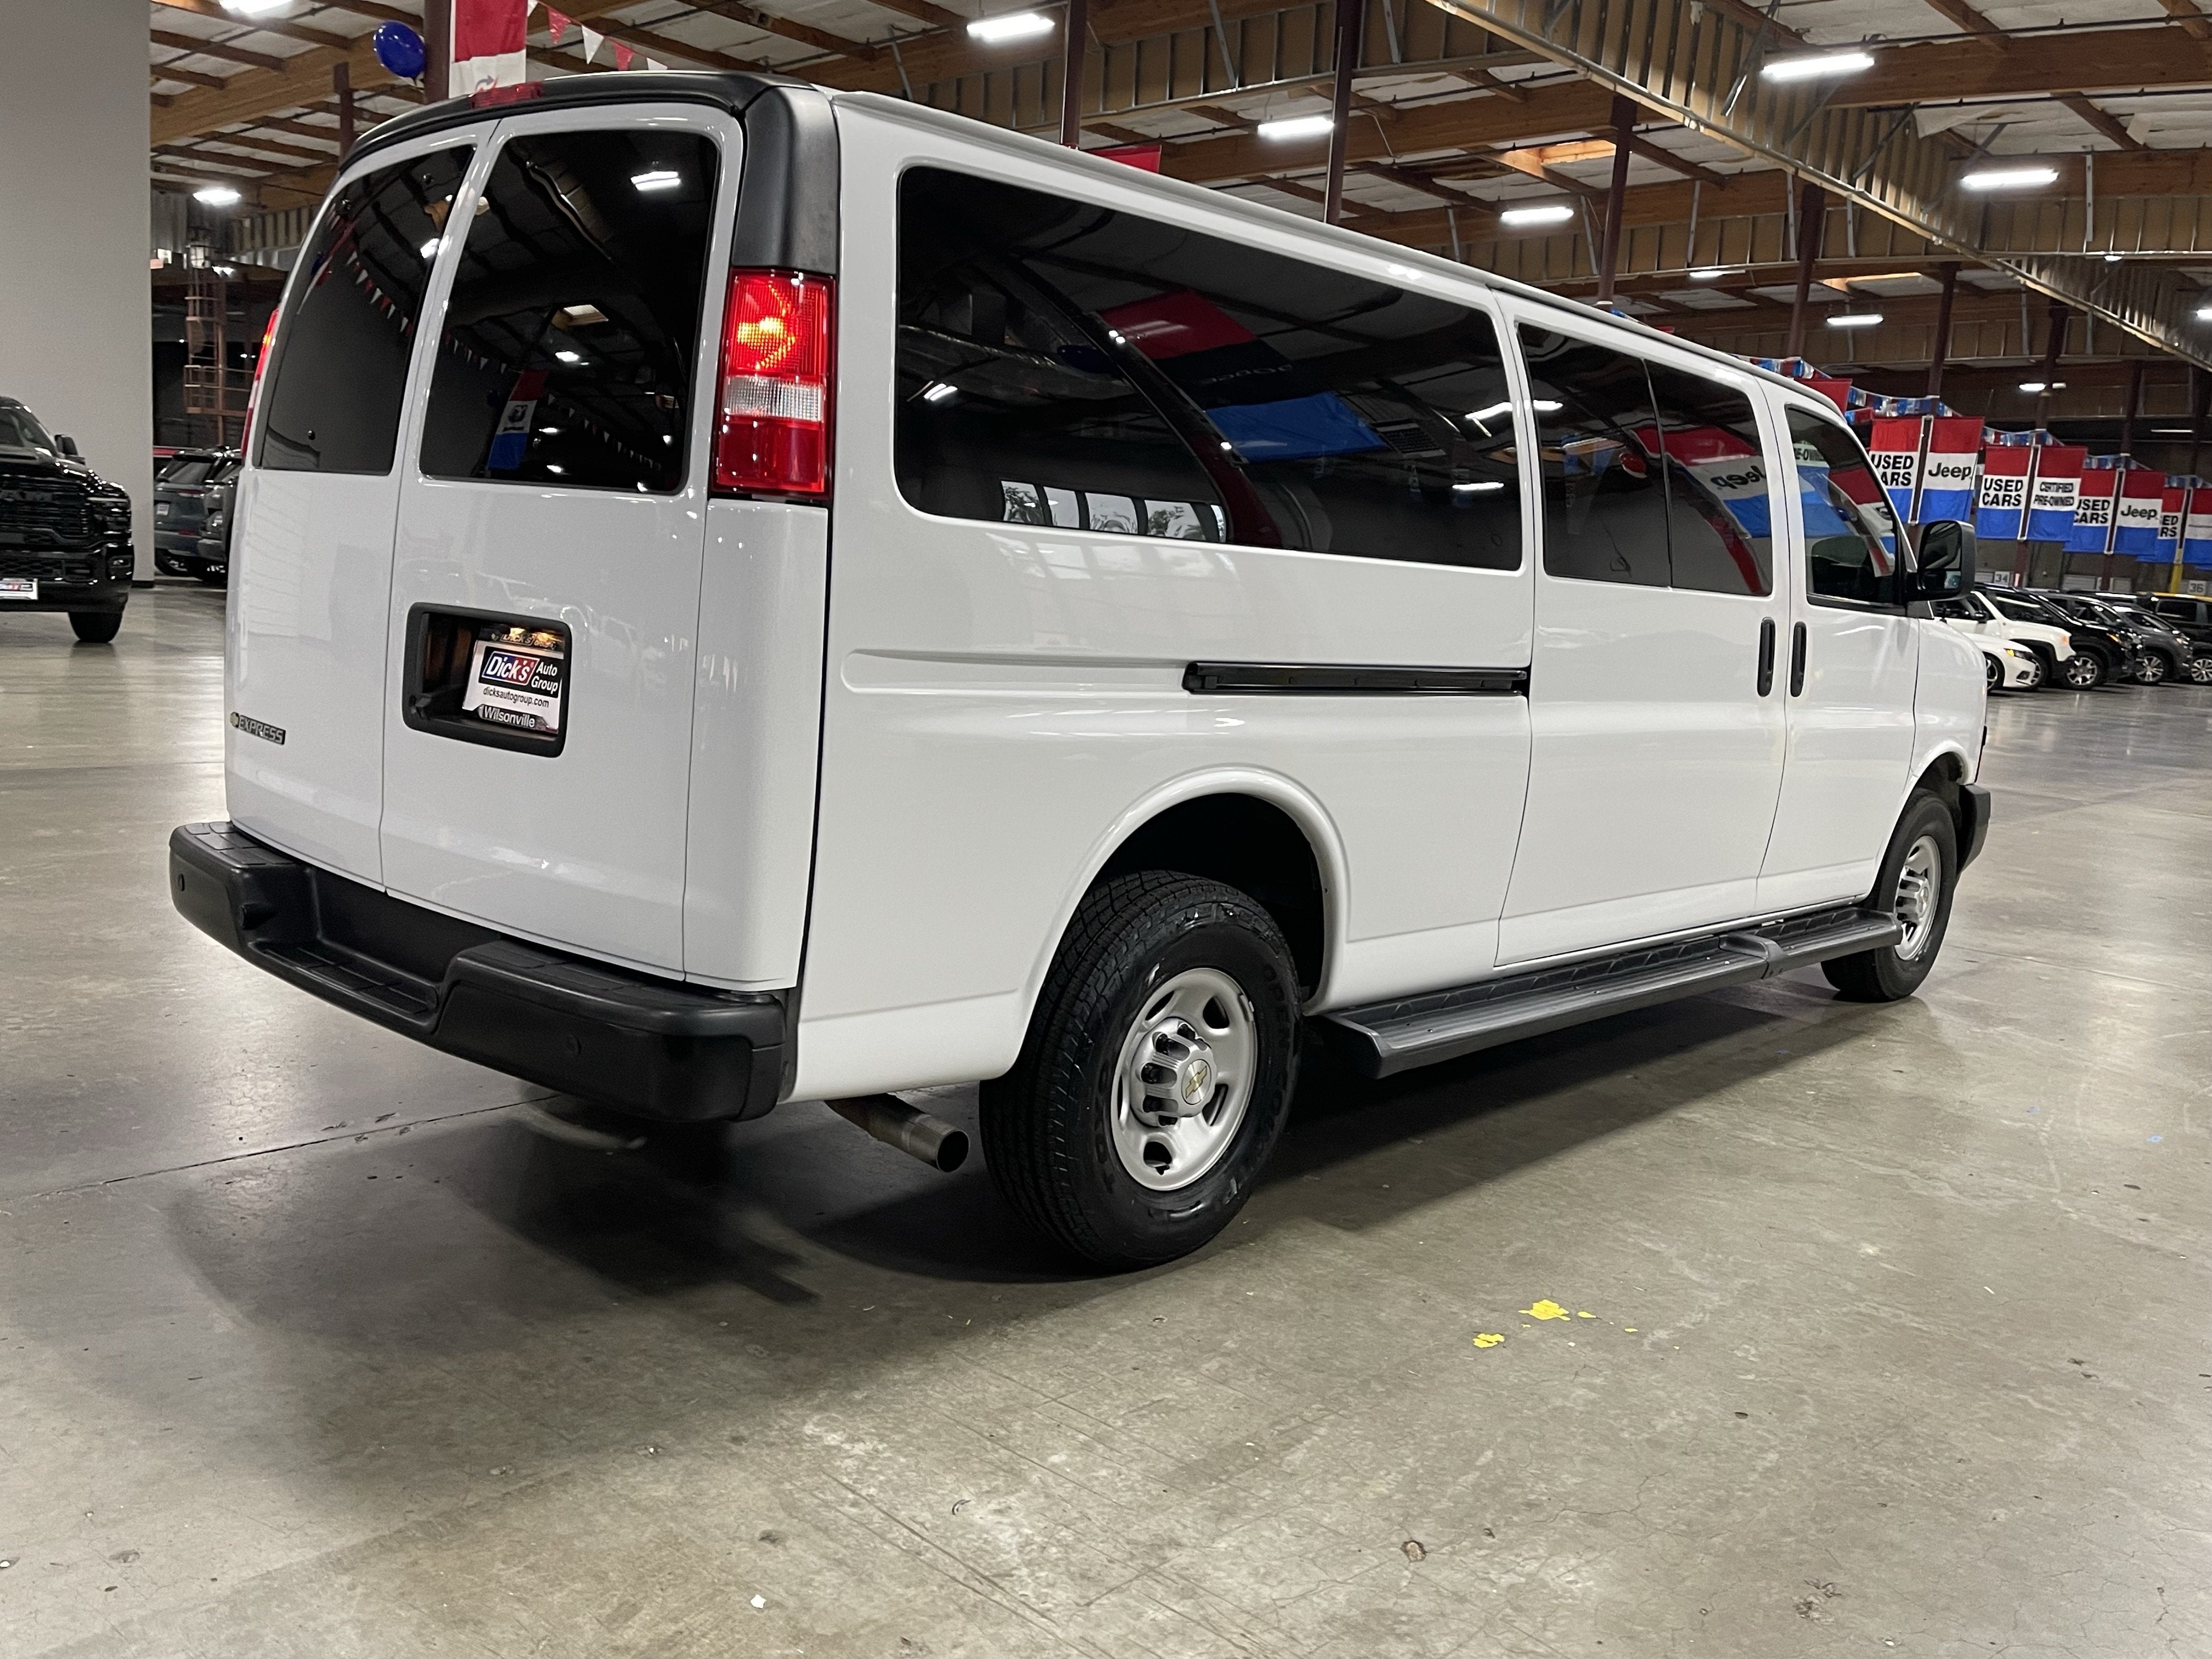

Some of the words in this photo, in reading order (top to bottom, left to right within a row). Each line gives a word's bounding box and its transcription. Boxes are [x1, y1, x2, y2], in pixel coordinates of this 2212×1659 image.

[1871, 454, 1914, 470] USED
[1881, 472, 1911, 486] ARS
[1928, 462, 1971, 481] Jeep
[1984, 478, 2023, 492] USED
[1982, 493, 2022, 506] CARS
[2121, 505, 2157, 520] Jeep
[1995, 573, 2008, 583] 34
[486, 656, 530, 681] Dick's
[536, 662, 557, 676] Auto
[531, 676, 558, 695] Group
[483, 686, 549, 708] dicksautogroup.com
[484, 706, 535, 727] Wilsonville
[239, 716, 284, 743] EXPRESS
